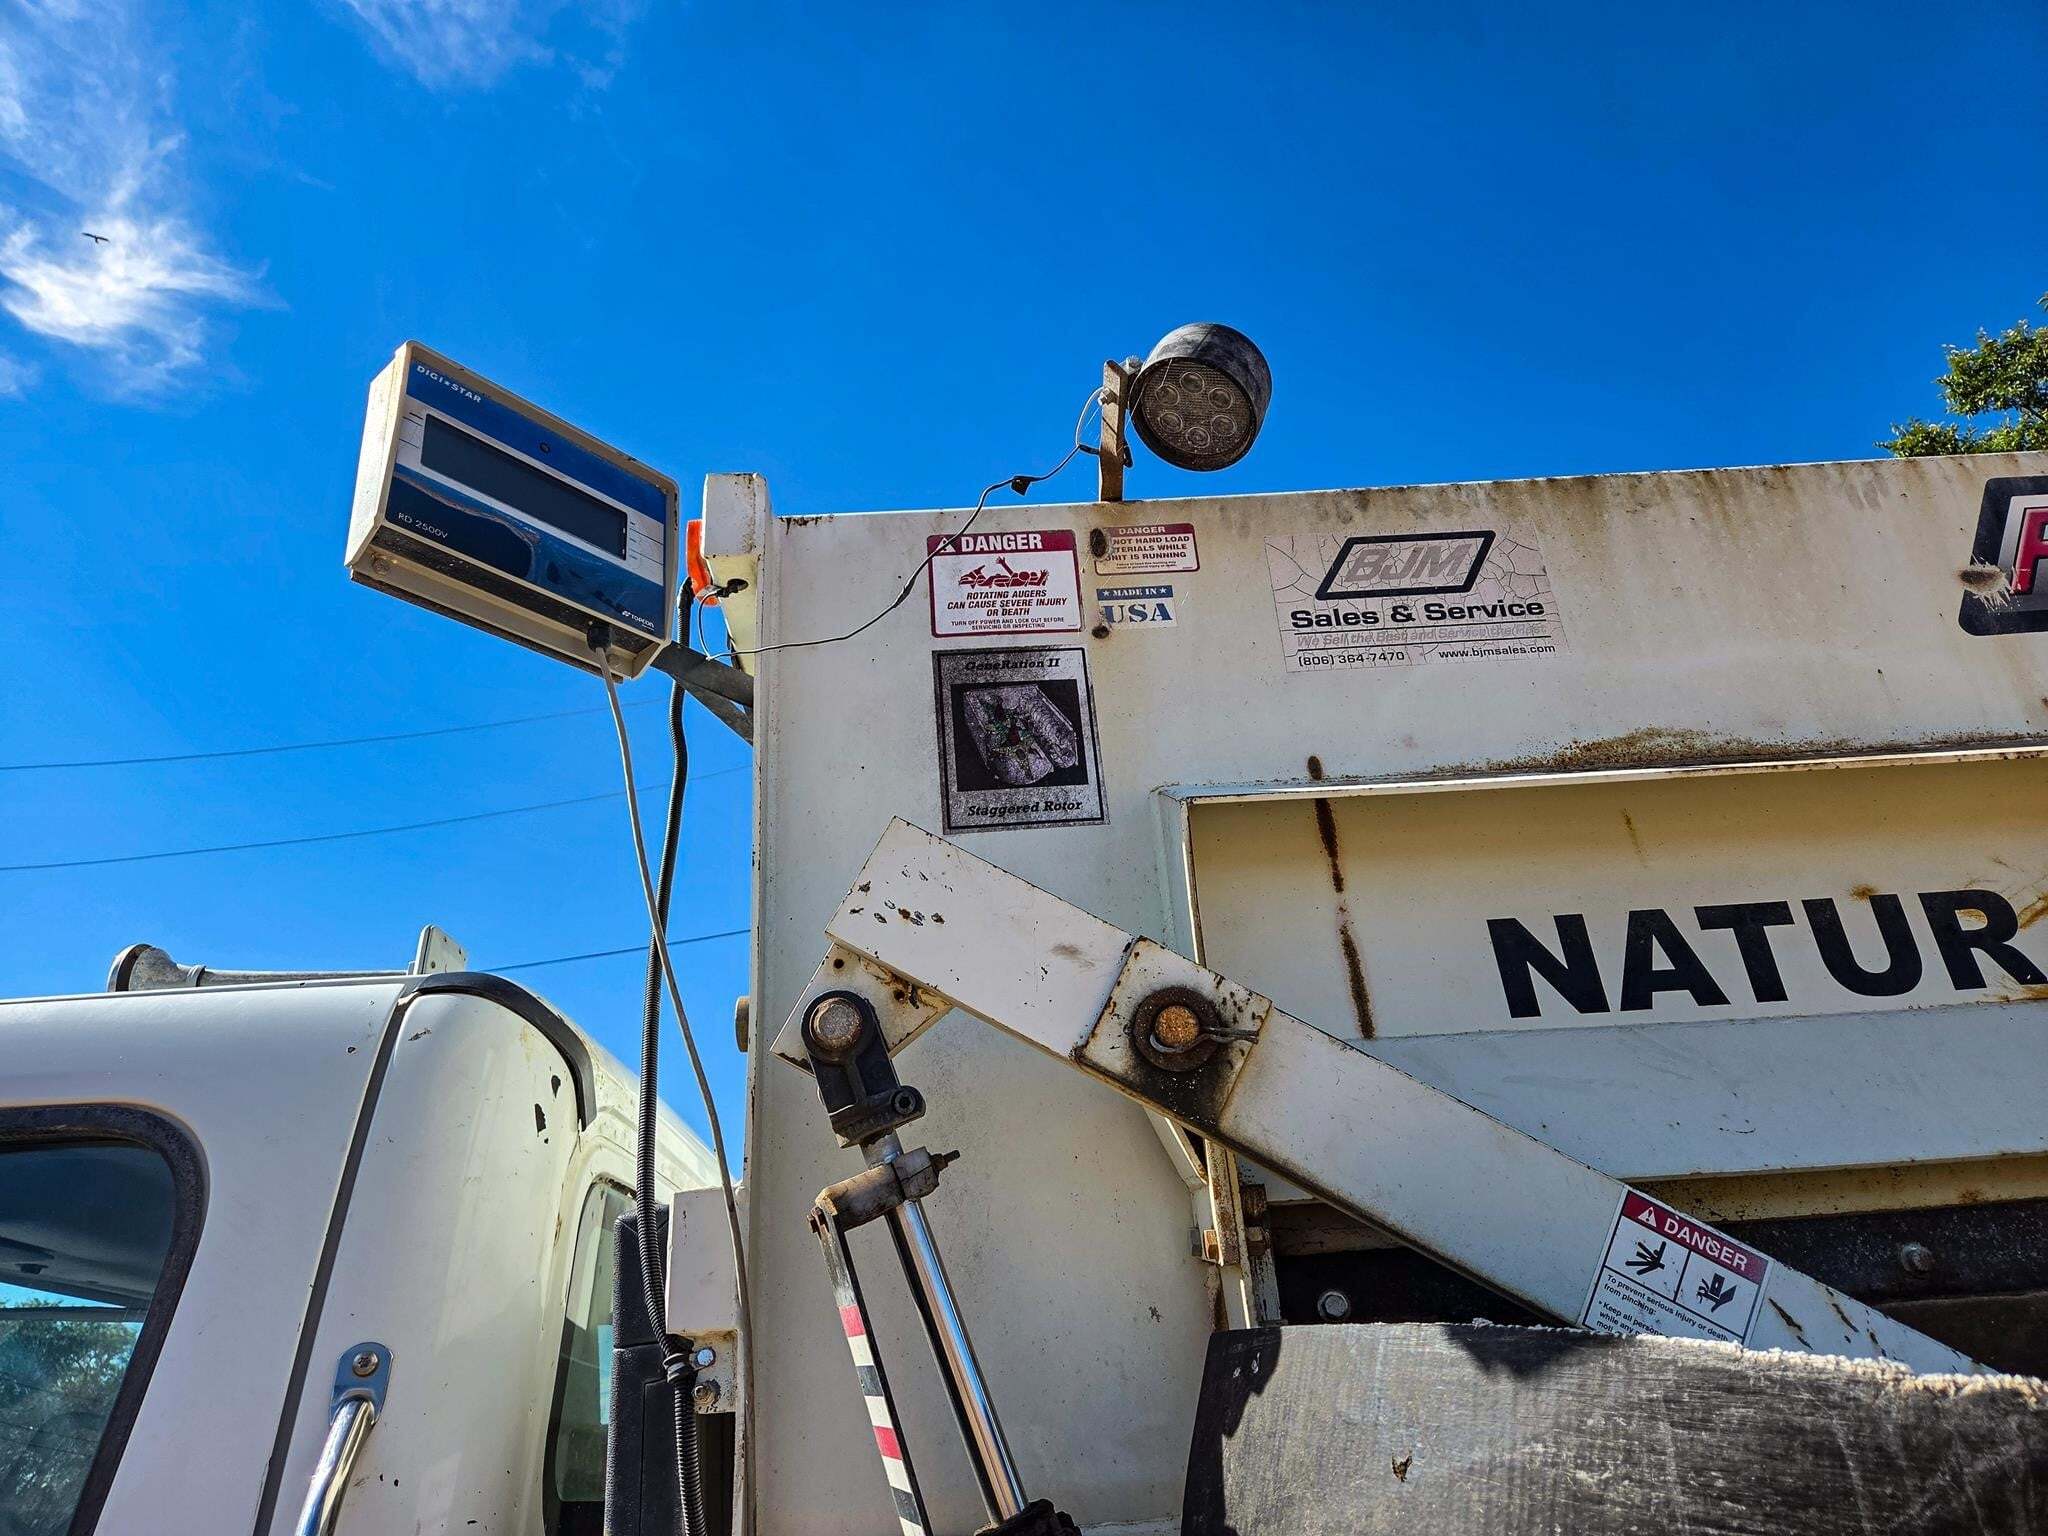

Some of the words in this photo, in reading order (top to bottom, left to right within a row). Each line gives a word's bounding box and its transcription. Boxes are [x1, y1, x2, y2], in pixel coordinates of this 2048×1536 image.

[416, 365, 444, 383] DIGI
[450, 383, 481, 403] STAR
[398, 512, 413, 523] RD
[415, 520, 448, 538] 2500V
[1118, 526, 1166, 535] DANGER
[961, 533, 1043, 552] DANGER
[1113, 544, 1155, 553] TERIALS
[1157, 543, 1188, 551] WHILE
[1135, 536, 1163, 544] HAND
[1164, 535, 1190, 543] LOAD
[1142, 551, 1187, 559] RUNNING
[1344, 543, 1473, 583] BJM
[966, 591, 1009, 600] ROTATING
[1012, 589, 1047, 598] AUGERS
[1112, 588, 1143, 597] MADE
[1145, 587, 1158, 595] IN
[947, 602, 965, 610] CAN
[968, 600, 997, 609] CAUSE
[999, 599, 1033, 608] SEVERE
[1035, 598, 1068, 606] INJURY
[1001, 608, 1030, 616] DEATH
[1101, 603, 1173, 625] USA
[1290, 608, 1380, 629] Sales
[1390, 604, 1416, 623] &
[1423, 600, 1545, 621] Service
[1297, 634, 1320, 648] We
[1322, 633, 1346, 646] Sell
[1351, 632, 1374, 644] the
[1376, 631, 1407, 643] Best
[1410, 629, 1435, 641] and
[1298, 654, 1335, 667] (806)
[1338, 651, 1405, 664] 364-7470
[1438, 645, 1556, 659] www.bjmsales.com
[1046, 658, 1060, 667] II
[967, 801, 1040, 818] Staggered
[1042, 800, 1084, 812] Rotor
[1486, 889, 2048, 1019] NATUR
[1663, 1217, 1748, 1272] DANGER
[1604, 1283, 1621, 1297] from
[1622, 1294, 1657, 1315] pinching:
[1607, 1274, 1617, 1284] To
[1617, 1281, 1646, 1300] prevent
[1647, 1296, 1674, 1314] serious
[1674, 1310, 1697, 1326] injury
[1697, 1323, 1707, 1331] or
[1603, 1301, 1621, 1317] Keep
[1623, 1313, 1633, 1322] all
[1599, 1311, 1619, 1325] while
[1619, 1322, 1634, 1334] any
